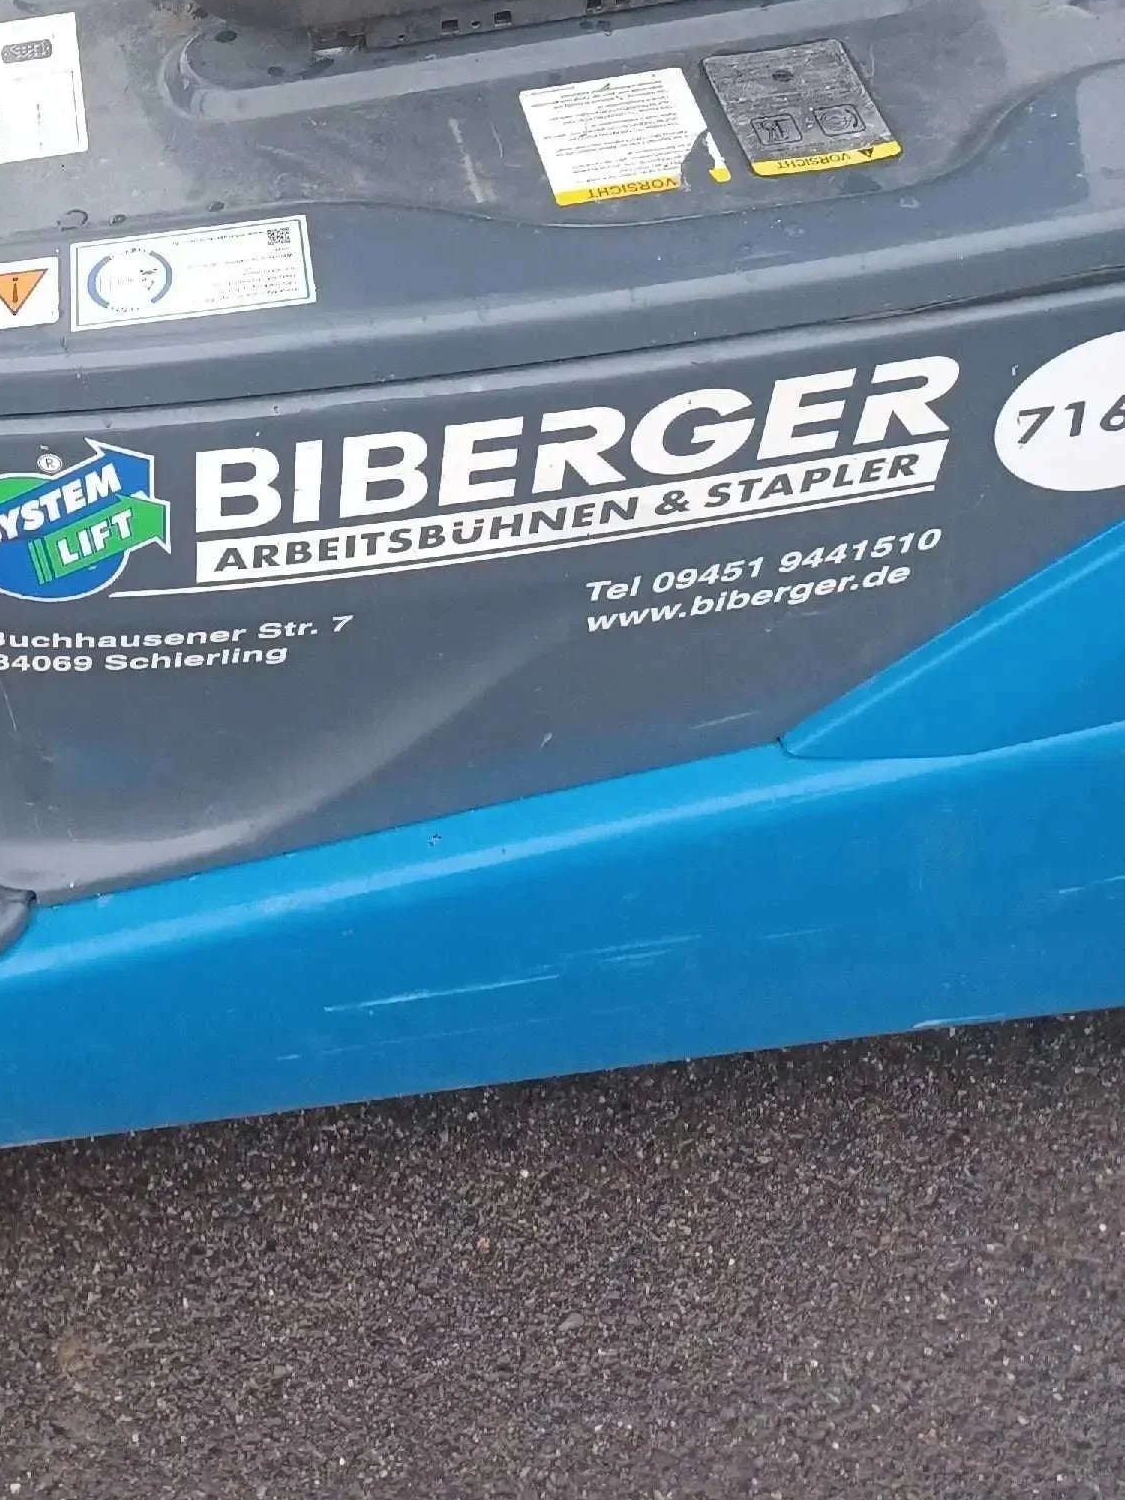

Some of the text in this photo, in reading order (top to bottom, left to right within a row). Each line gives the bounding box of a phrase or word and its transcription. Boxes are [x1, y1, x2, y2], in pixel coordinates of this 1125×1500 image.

[586, 176, 678, 201] VORSICHT
[775, 153, 852, 171] VORSICHT
[195, 355, 960, 533] BIBERGER
[57, 508, 133, 566] LIFT
[213, 452, 920, 573] ARBEITSBÜHNEN & STAPLER
[586, 528, 942, 603] Tel 09451 9441510
[258, 620, 318, 639] Str.
[331, 615, 355, 633] 7
[587, 563, 912, 633] www.biberger.de
[104, 644, 289, 672] Schierling
